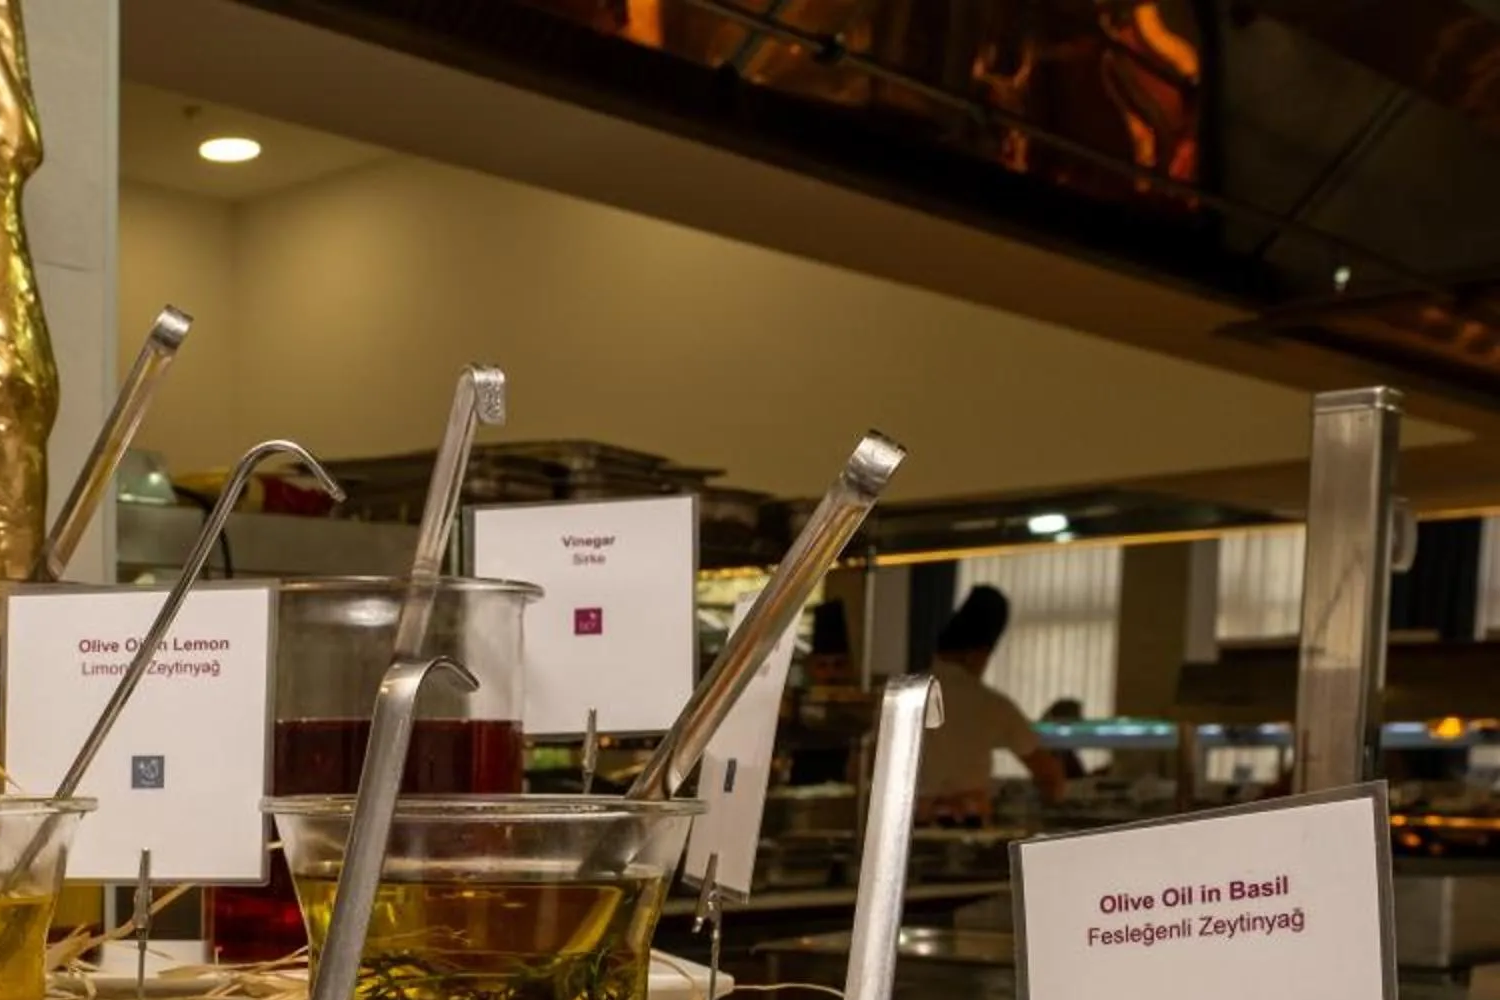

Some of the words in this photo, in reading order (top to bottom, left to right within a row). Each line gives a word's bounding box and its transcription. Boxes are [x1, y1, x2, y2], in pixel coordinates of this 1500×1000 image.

[561, 535, 616, 549] Vinegar
[79, 638, 119, 654] Olive
[125, 637, 148, 653] Oi
[173, 636, 230, 652] Lemon
[81, 661, 136, 677] Limon
[1100, 893, 1155, 915] Olive
[1162, 885, 1193, 908] Oil
[1200, 884, 1222, 905] in
[1229, 875, 1289, 901] Basil
[1087, 918, 1192, 947] Fesleğenli
[1199, 907, 1305, 940] Zeytinyağ
